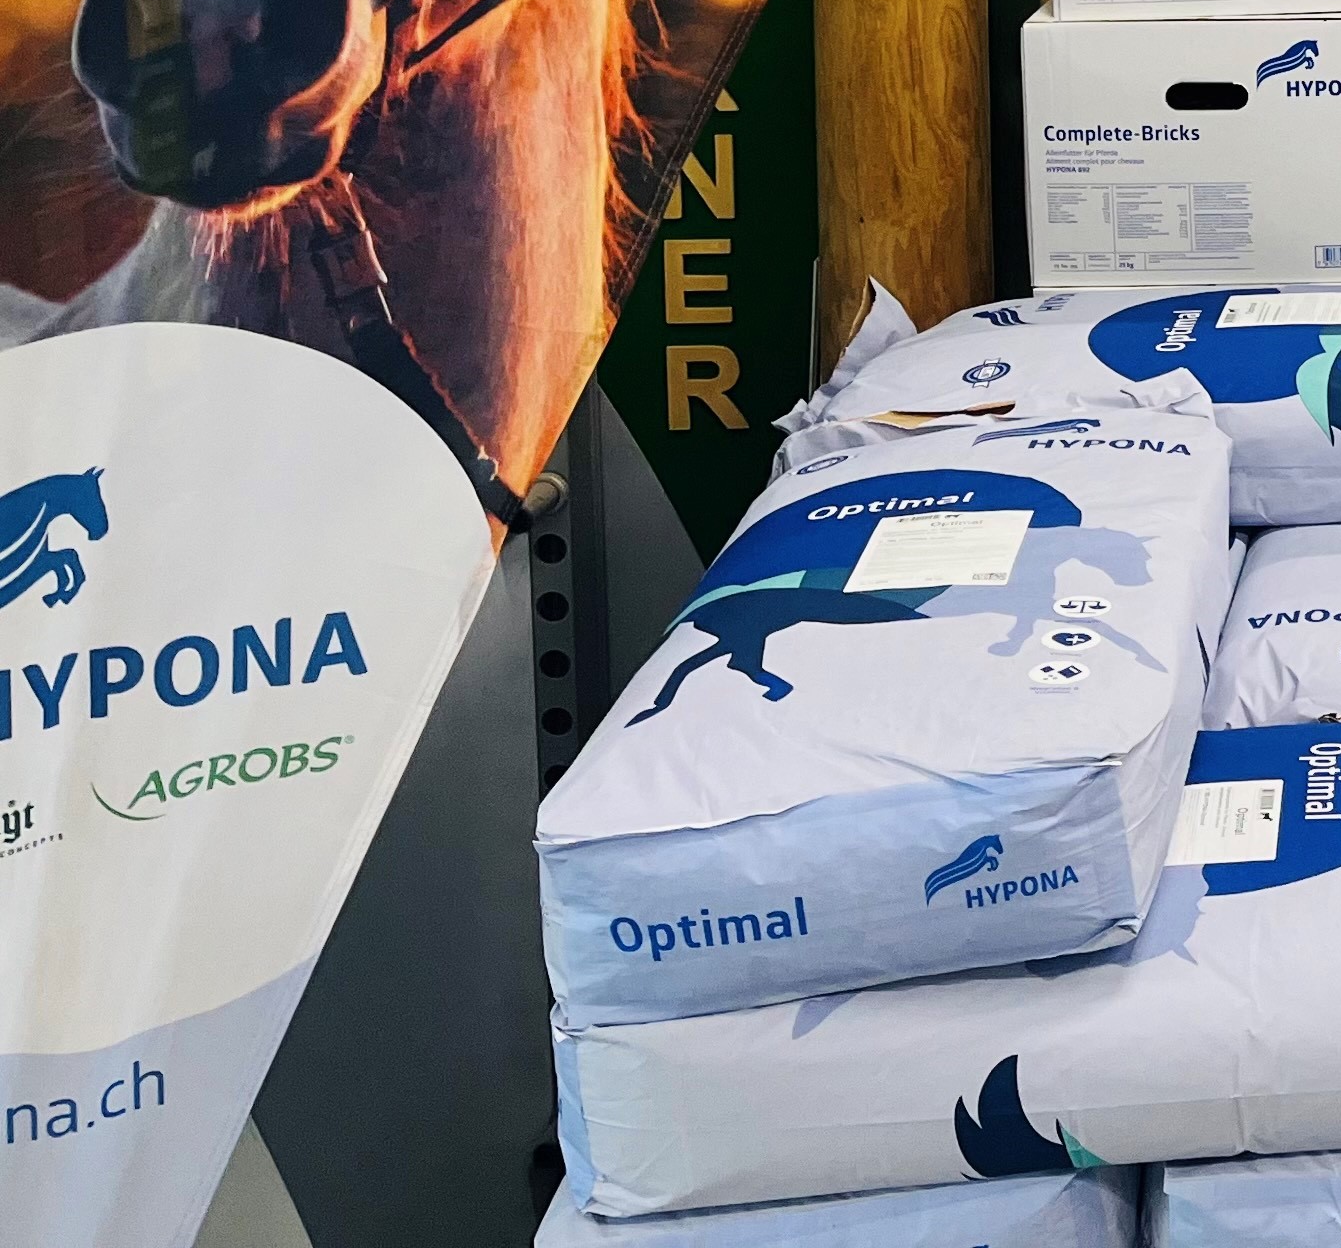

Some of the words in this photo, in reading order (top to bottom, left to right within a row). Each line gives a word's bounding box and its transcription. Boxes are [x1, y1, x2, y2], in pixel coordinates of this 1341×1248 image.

[1044, 125, 1200, 146] Complete-Bricks
[1155, 310, 1202, 352] Optimal
[1029, 438, 1191, 456] HYPONA
[807, 491, 975, 522] Optimal
[965, 865, 1079, 909] HYPONA
[609, 897, 809, 962] Optimal
